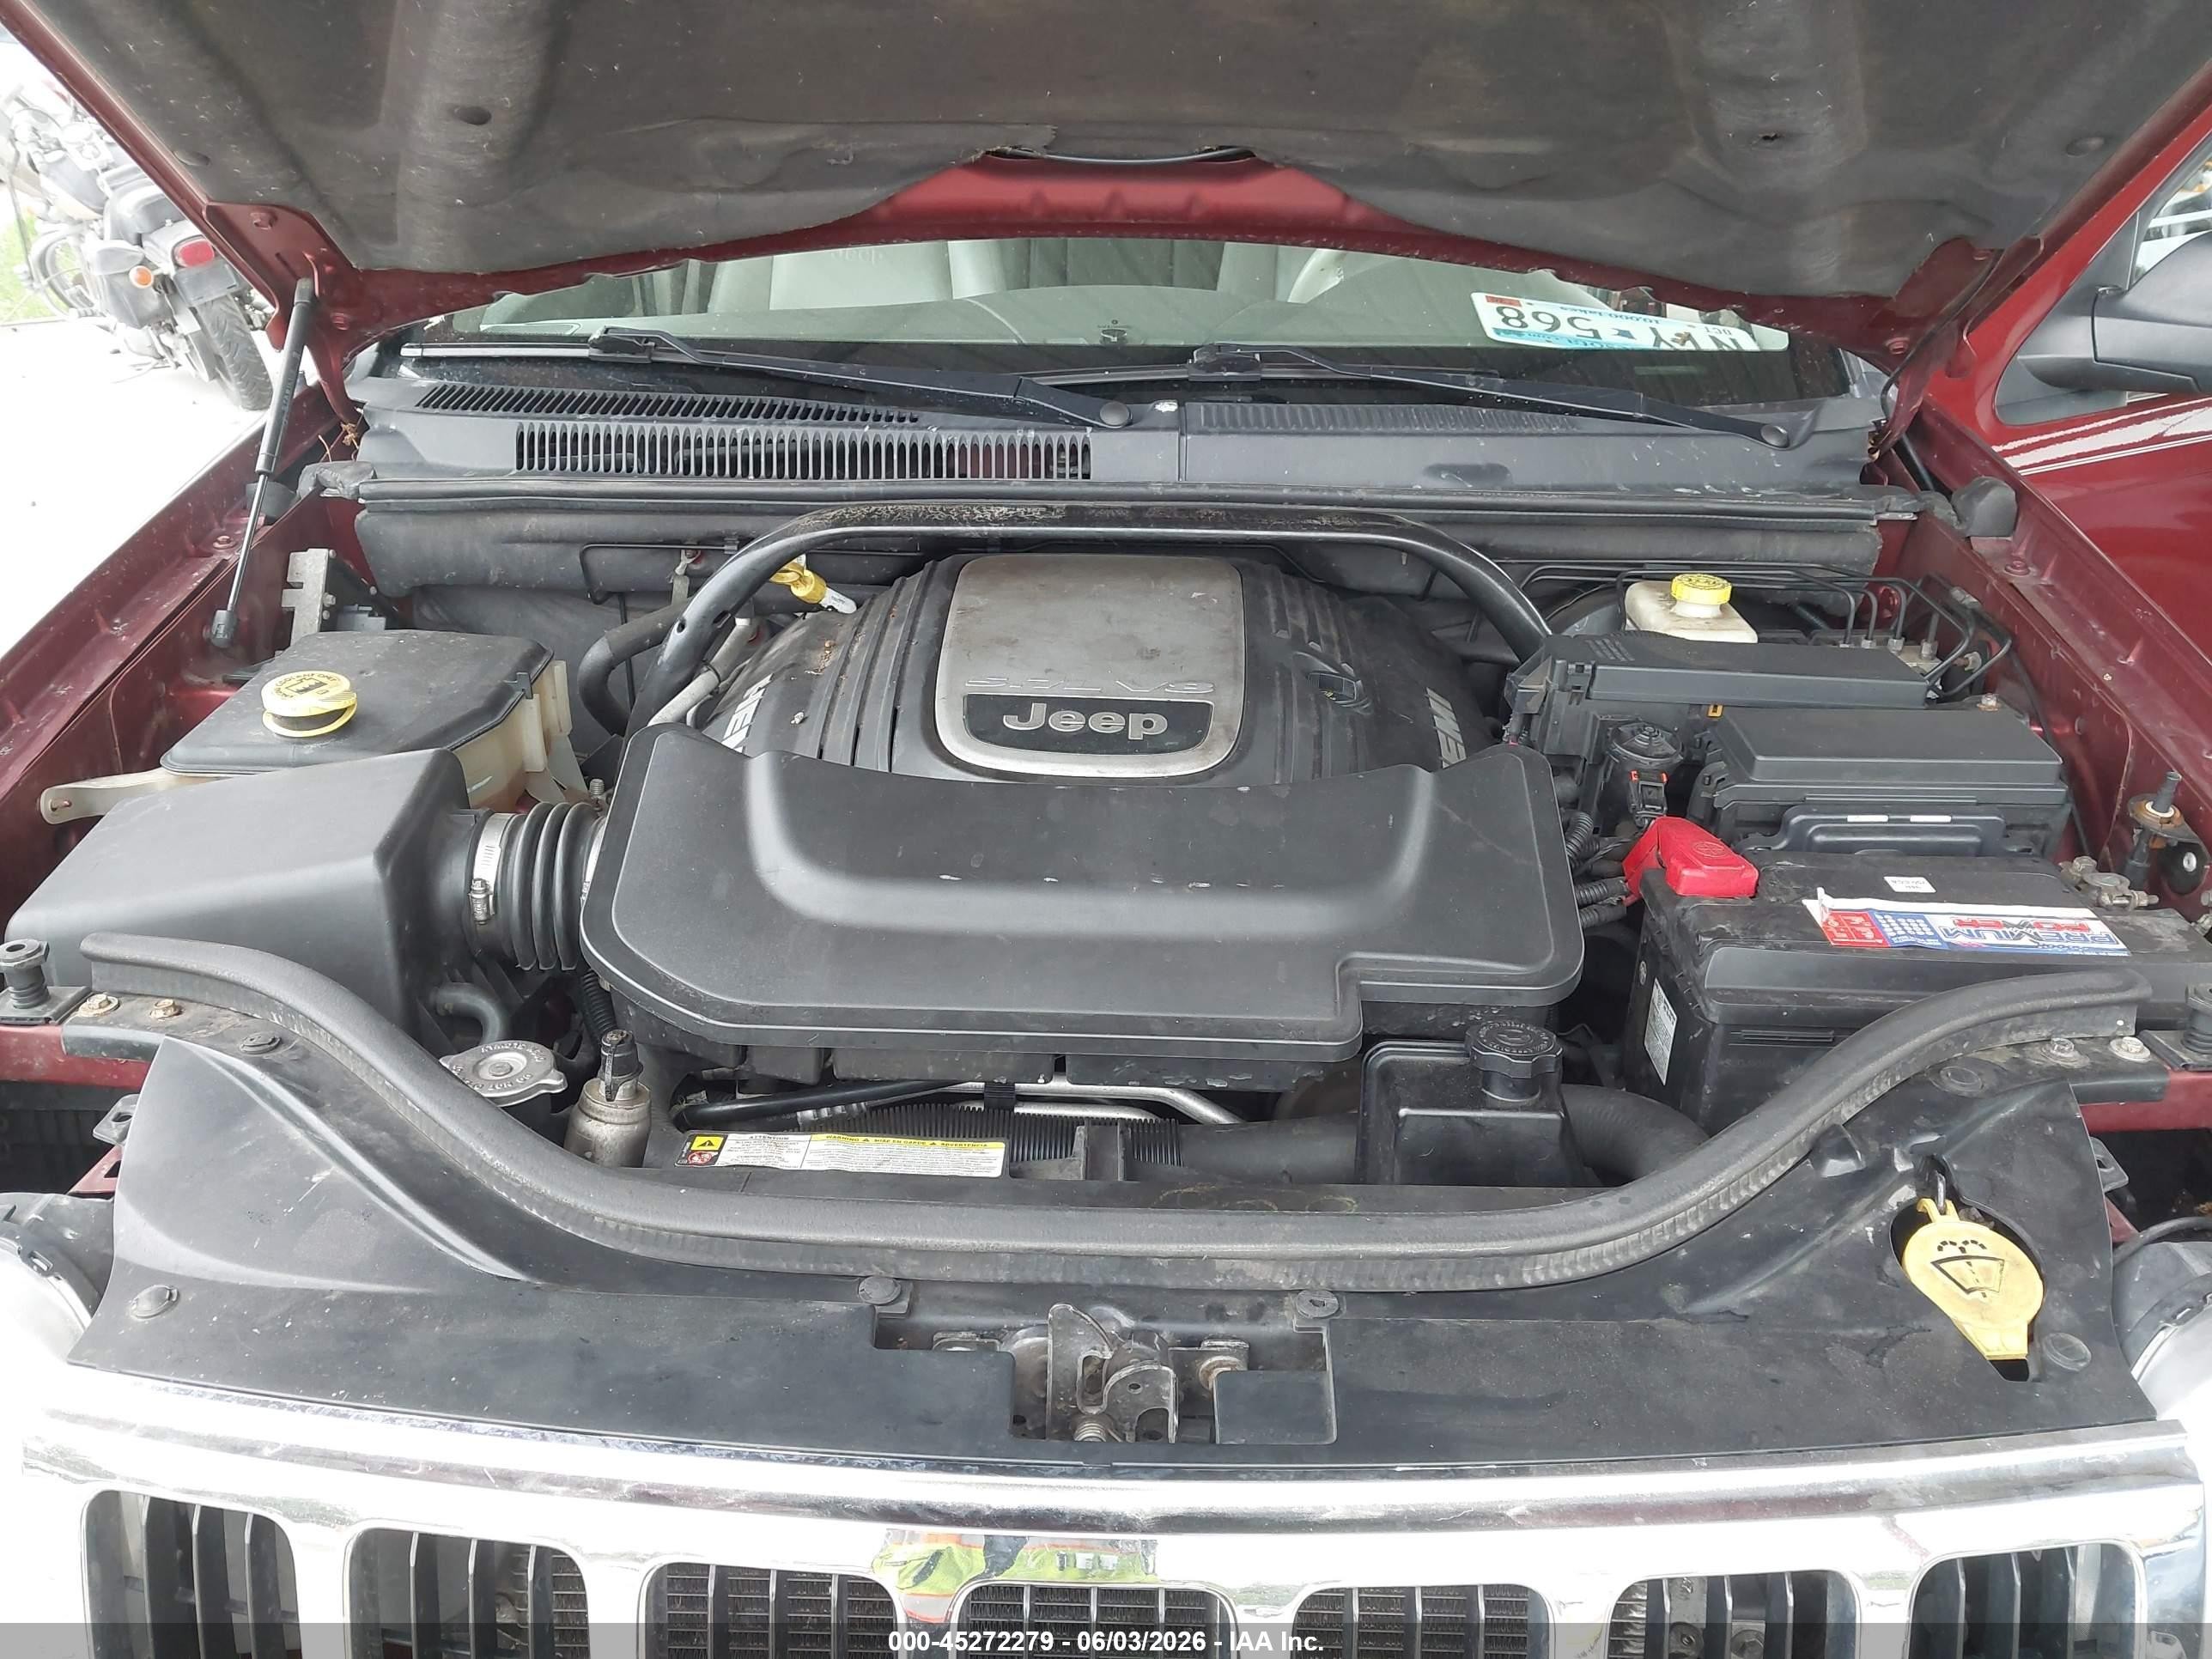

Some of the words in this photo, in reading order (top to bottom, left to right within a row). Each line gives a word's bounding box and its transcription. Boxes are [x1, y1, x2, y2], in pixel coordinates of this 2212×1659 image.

[1496, 306, 1603, 341] 568
[1002, 702, 1169, 740] Jeep
[1425, 686, 1468, 769] EMI
[1938, 926, 2119, 945] PREMIUM
